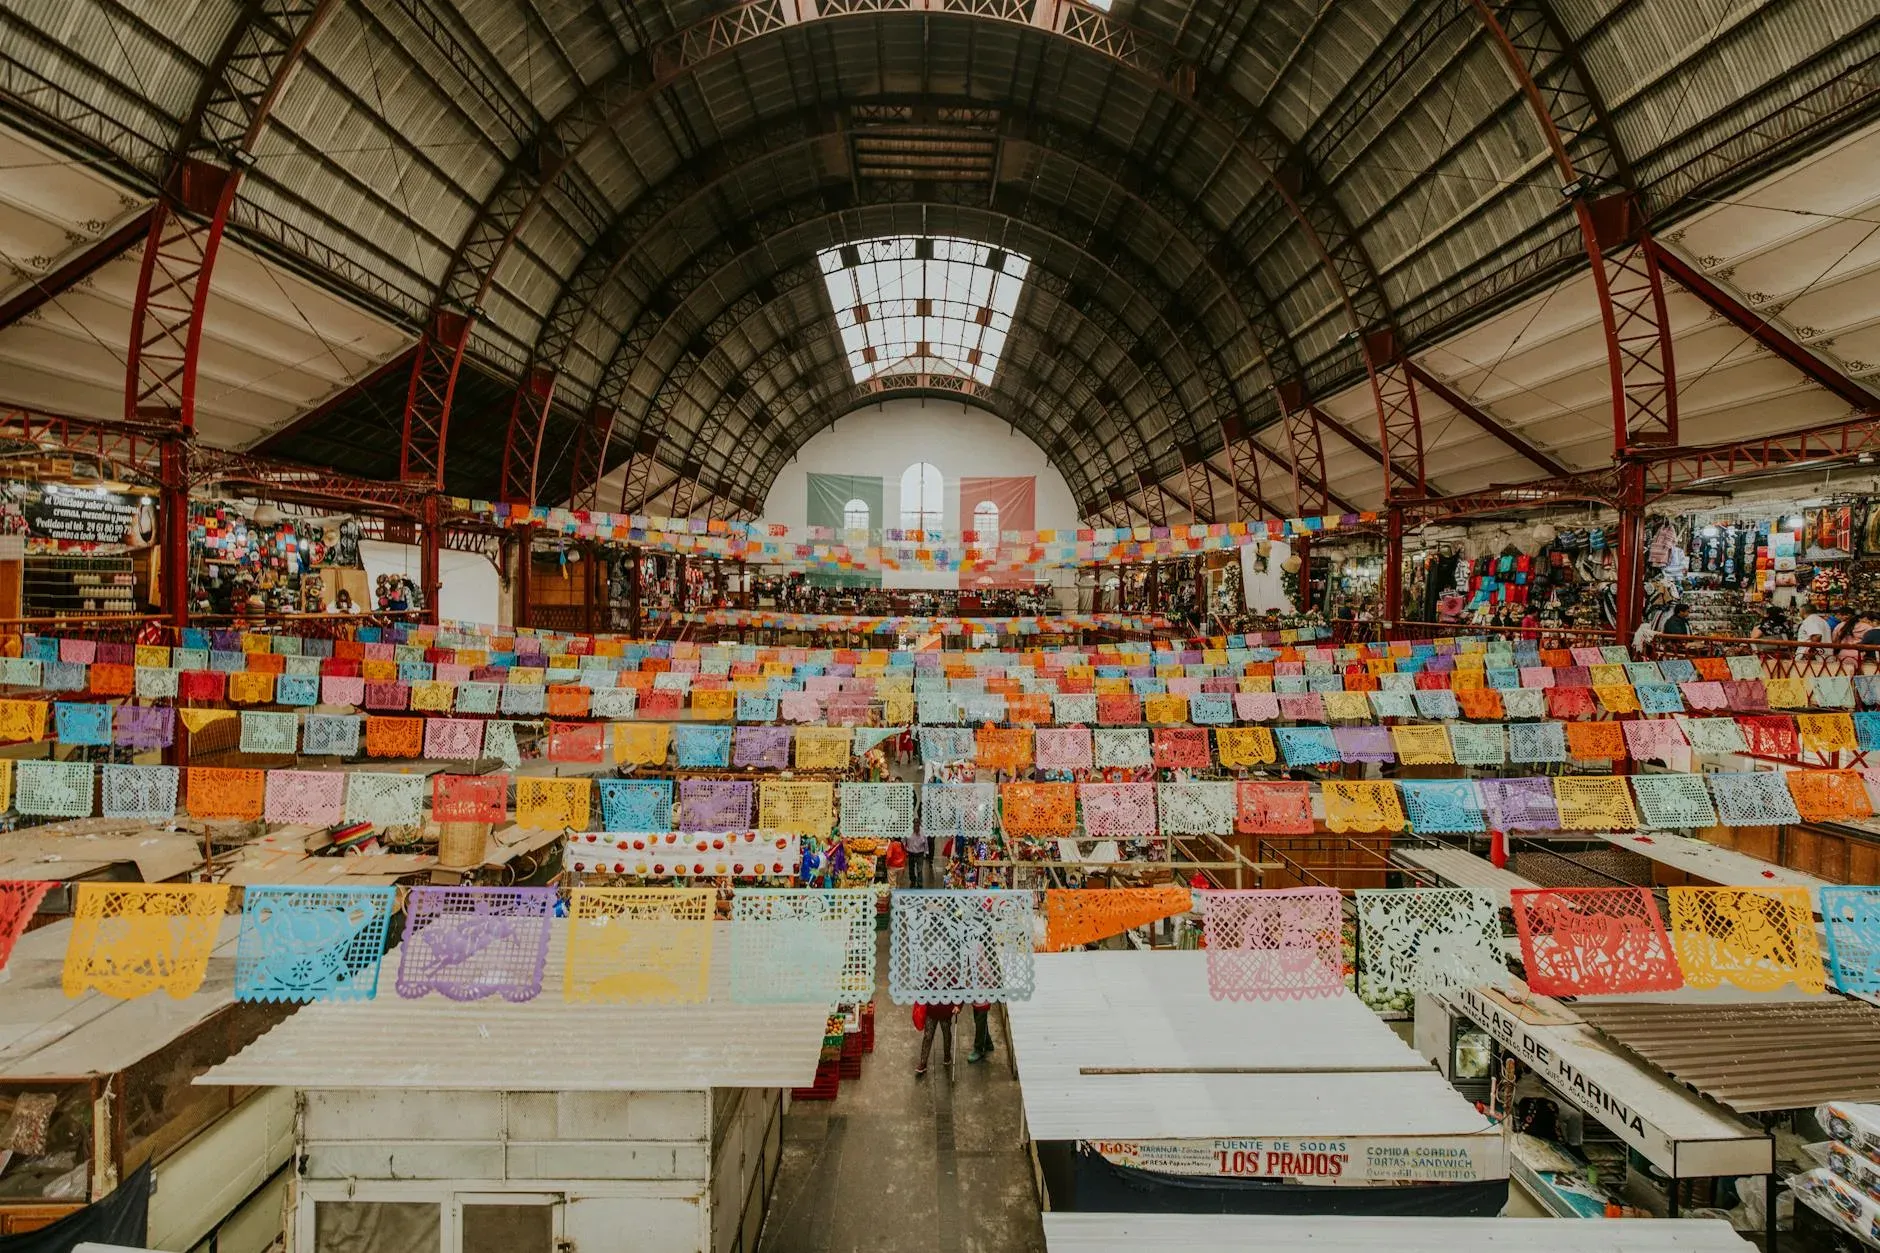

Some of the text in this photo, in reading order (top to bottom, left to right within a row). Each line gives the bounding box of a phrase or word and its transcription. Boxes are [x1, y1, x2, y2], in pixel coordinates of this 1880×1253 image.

[1523, 1034, 1549, 1065] DE
[1560, 1059, 1645, 1139] HARINA
[1214, 1140, 1346, 1151] FUENTE DE SODAS
